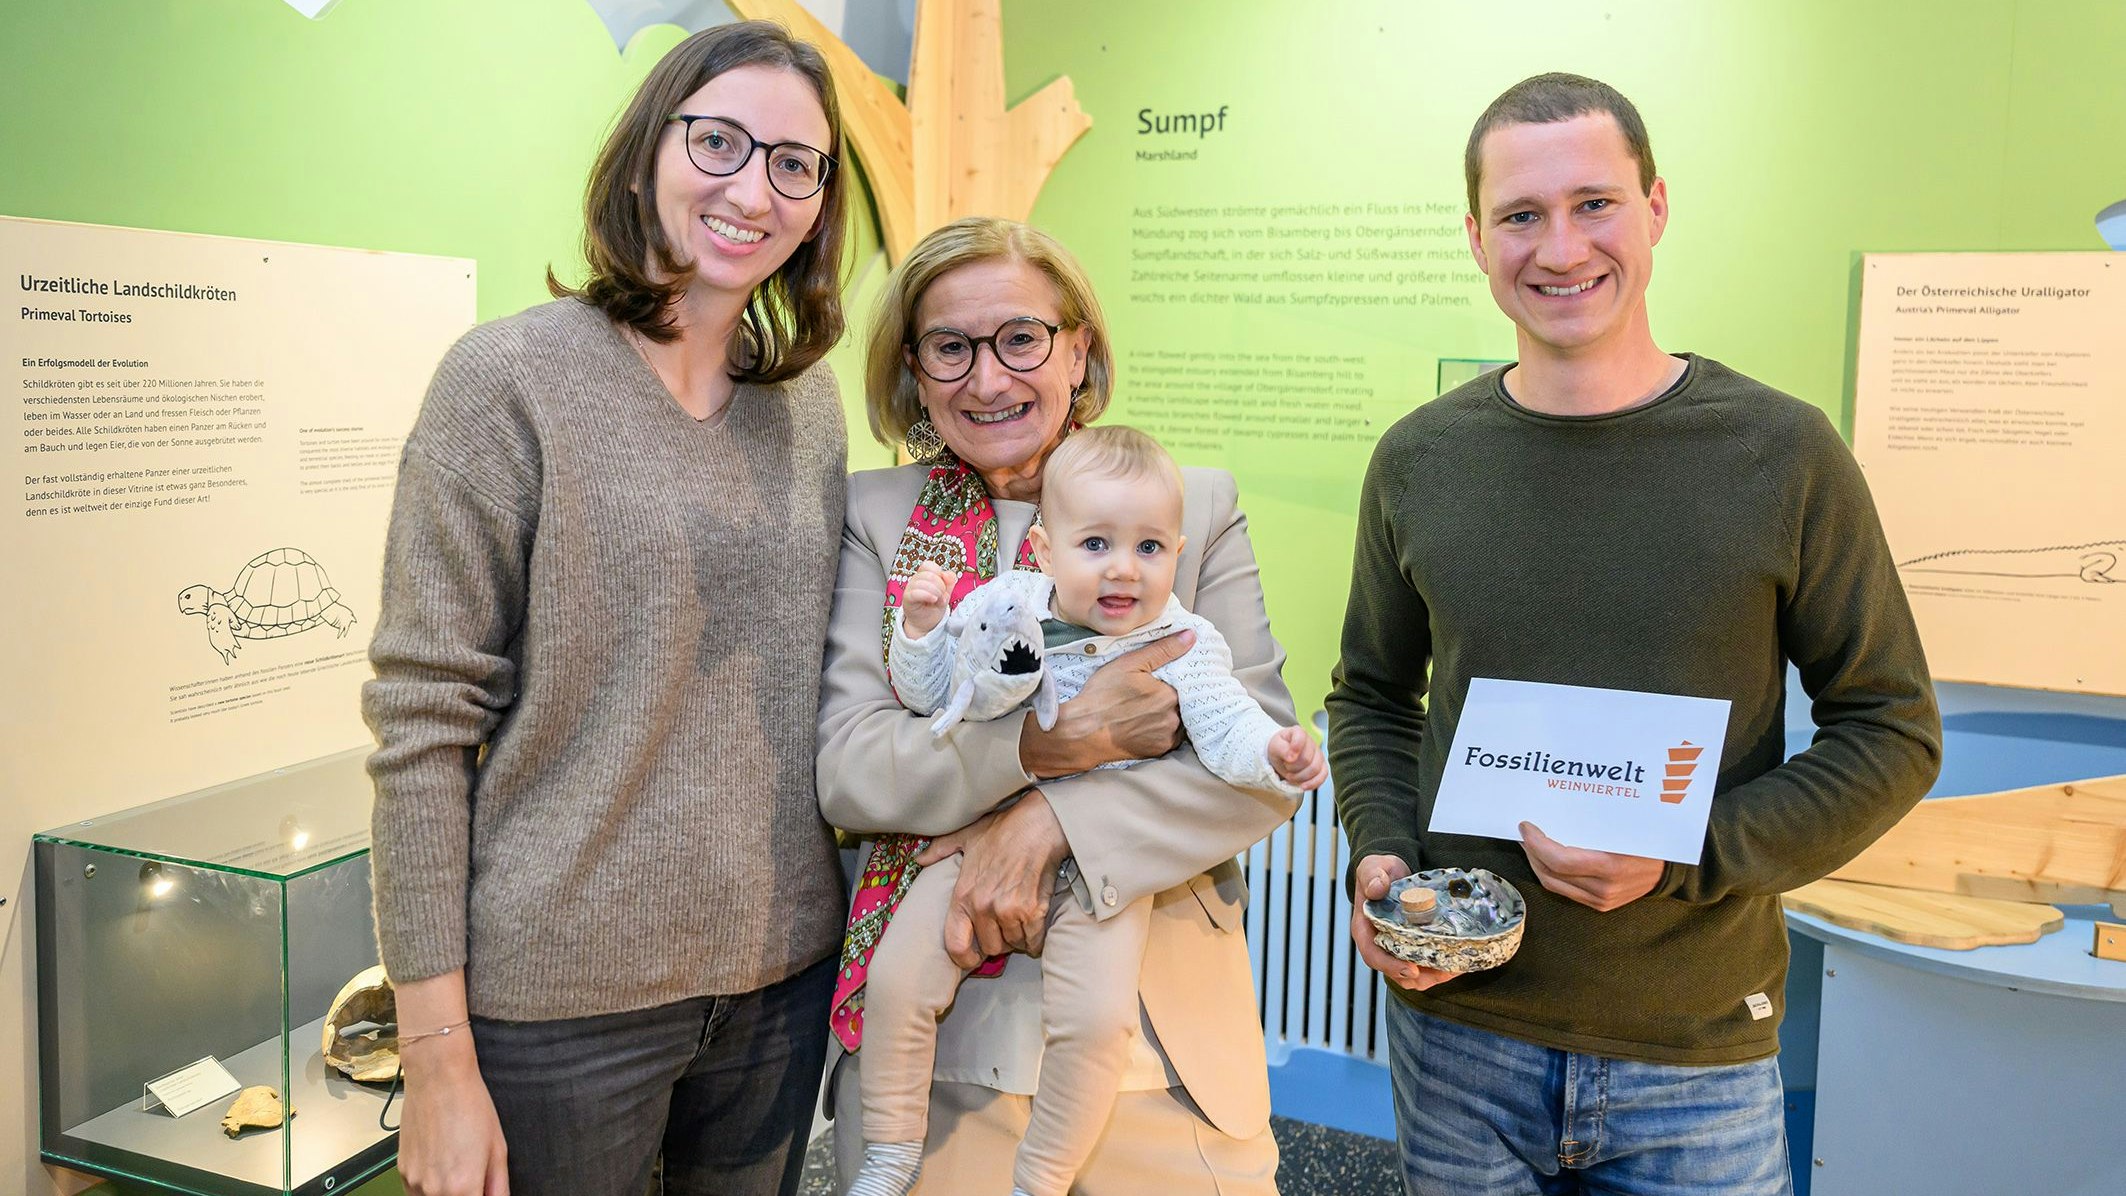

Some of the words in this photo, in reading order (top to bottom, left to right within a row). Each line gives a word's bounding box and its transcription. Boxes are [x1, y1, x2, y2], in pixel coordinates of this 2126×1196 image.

[1138, 106, 1229, 138] Sumpf
[1136, 150, 1198, 161] Marshland
[1133, 208, 1154, 218] Aus
[1156, 206, 1219, 218] Südwesten
[1222, 206, 1267, 217] strömte
[1270, 204, 1340, 219] gemächlich
[1343, 205, 1363, 216] ein
[1366, 202, 1399, 215] Fluss
[1403, 203, 1422, 215] ins
[1425, 202, 1458, 214] Meer.
[1132, 228, 1186, 242] Mündung
[1188, 230, 1209, 242] zog
[1212, 228, 1235, 239] sich
[1238, 229, 1264, 239] vom
[1267, 227, 1331, 241] Bisamberg
[1334, 226, 1352, 239] bis
[1355, 225, 1463, 240] Obergänserndorf
[1131, 249, 1229, 261] Sumpflandschaft,
[1231, 249, 1242, 260] in
[1246, 249, 1266, 261] der
[1269, 249, 1293, 261] sich
[1296, 248, 1326, 261] Salz-
[1328, 248, 1352, 260] und
[1356, 248, 1423, 260] Süßwasser
[1131, 270, 1190, 282] Zahlreiche
[1194, 270, 1259, 282] Seitenarme
[1262, 270, 1324, 282] umflossen
[1327, 271, 1365, 283] kleine
[1368, 271, 1393, 283] und
[1396, 271, 1447, 285] größere
[21, 275, 109, 295] Urzeitliche
[114, 282, 236, 301] Landschildkröten
[1897, 286, 1917, 296] Der
[1921, 285, 2017, 297] Österreichische
[2021, 287, 2090, 299] Uralligator
[1129, 292, 1166, 303] wuchs
[1168, 294, 1187, 304] ein
[1190, 292, 1230, 304] dichter
[1233, 293, 1263, 304] Wald
[1266, 295, 1287, 304] aus
[1290, 293, 1389, 306] Sumpfzypressen
[1393, 294, 1417, 306] und
[1421, 293, 1472, 306] Palmen.
[21, 307, 76, 321] Primeval
[78, 310, 132, 324] Tortoises
[1895, 306, 1933, 314] Austria's
[1936, 306, 1977, 314] Primeval
[1979, 306, 2020, 316] Alligator
[22, 358, 36, 367] Ein
[38, 358, 96, 369] Erfolgsmodell
[97, 359, 111, 368] der
[112, 359, 149, 368] Evolution
[22, 380, 76, 389] Schildkröten
[77, 380, 94, 391] gibt
[95, 381, 105, 389] es
[106, 380, 121, 388] seit
[122, 380, 140, 388] über
[142, 379, 157, 388] 220
[158, 380, 193, 388] Millionen
[194, 380, 219, 388] Jahren.
[219, 379, 231, 388] Sie
[231, 380, 253, 388] haben
[253, 380, 265, 388] die
[23, 396, 90, 405] verschiedensten
[92, 395, 144, 404] Lebensräume
[145, 395, 160, 403] und
[161, 394, 209, 404] ökologischen
[210, 394, 238, 402] Nischen
[239, 394, 265, 402] erobert,
[23, 412, 48, 421] leben
[50, 411, 61, 420] im
[62, 411, 91, 420] Wasser
[93, 411, 111, 420] oder
[124, 410, 144, 419] Land
[145, 410, 160, 418] und
[161, 409, 188, 418] fressen
[189, 408, 214, 417] Fleisch
[215, 408, 231, 416] oder
[232, 407, 261, 416] Pflanzen
[23, 428, 44, 437] oder
[45, 427, 75, 436] beides.
[75, 426, 92, 435] Alle
[94, 425, 143, 435] Schildkröten
[144, 424, 168, 433] haben
[169, 424, 189, 432] einen
[190, 423, 214, 431] Panzer
[228, 422, 253, 430] Rücken
[253, 421, 267, 429] und
[40, 443, 66, 452] Bauch
[67, 442, 84, 451] und
[85, 442, 108, 452] legen
[110, 440, 127, 450] Eier,
[127, 440, 140, 449] die
[156, 439, 169, 448] der
[170, 438, 194, 447] Sonne
[195, 437, 236, 447] ausgebrütet
[25, 476, 41, 485] Der
[42, 475, 59, 484] fast
[60, 472, 105, 483] vollständig
[107, 471, 144, 480] erhaltene
[145, 469, 170, 478] Panzer
[172, 468, 191, 476] einer
[192, 466, 233, 475] urzeitlichen
[25, 489, 91, 501] Landschildkröte
[93, 488, 101, 496] in
[102, 487, 127, 496] dieser
[127, 484, 154, 493] Vitrine
[155, 483, 165, 492] ist
[165, 483, 188, 491] etwas
[188, 482, 206, 492] ganz
[207, 479, 248, 488] Besonderes,
[25, 508, 47, 517] denn
[49, 508, 59, 516] es
[61, 505, 71, 514] ist
[73, 503, 108, 513] weltweit
[109, 502, 123, 510] der
[124, 500, 152, 510] einzige
[153, 498, 173, 506] Fund
[173, 497, 196, 505] dieser
[1464, 746, 1646, 784] Fossilienwelt
[1547, 778, 1641, 799] WEINVIERTEL
